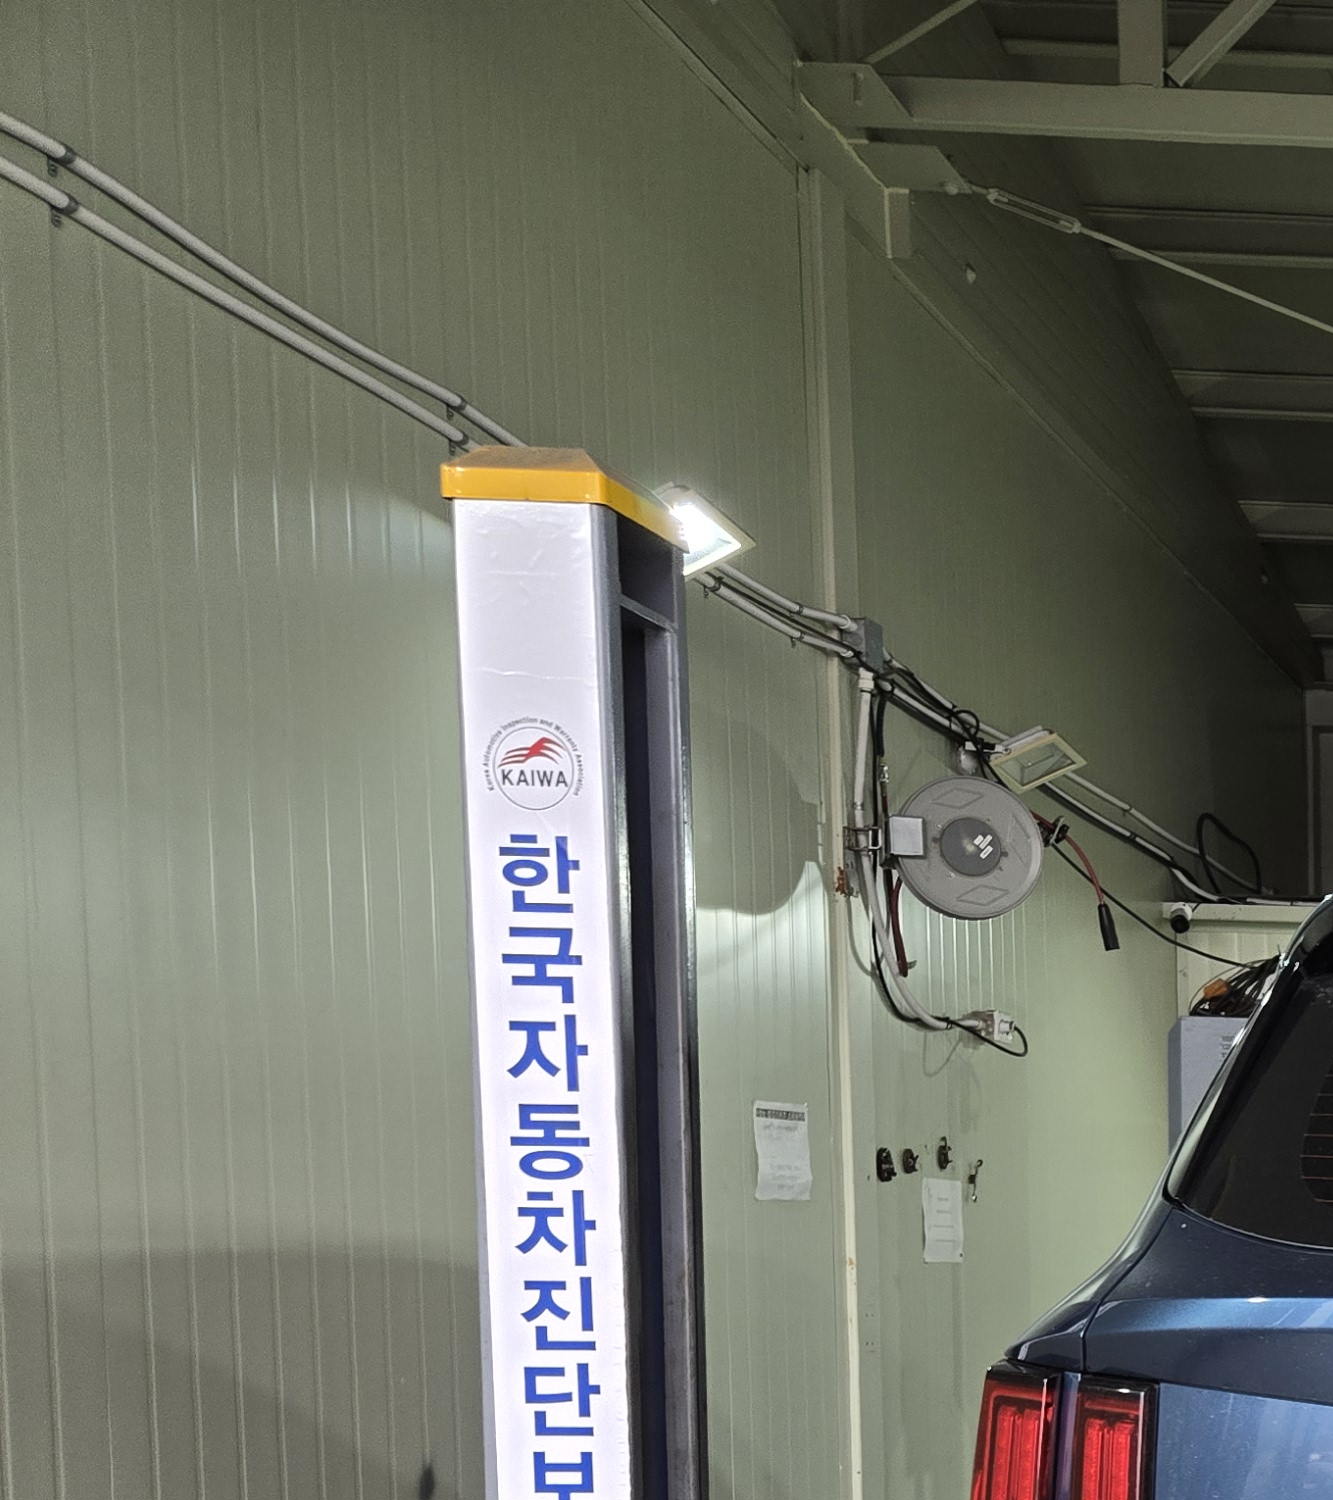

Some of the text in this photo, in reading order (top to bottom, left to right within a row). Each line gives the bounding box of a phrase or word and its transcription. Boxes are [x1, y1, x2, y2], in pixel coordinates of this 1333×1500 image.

[500, 716, 538, 731] Inspection
[539, 718, 554, 728] and
[501, 769, 569, 788] KAIWA
